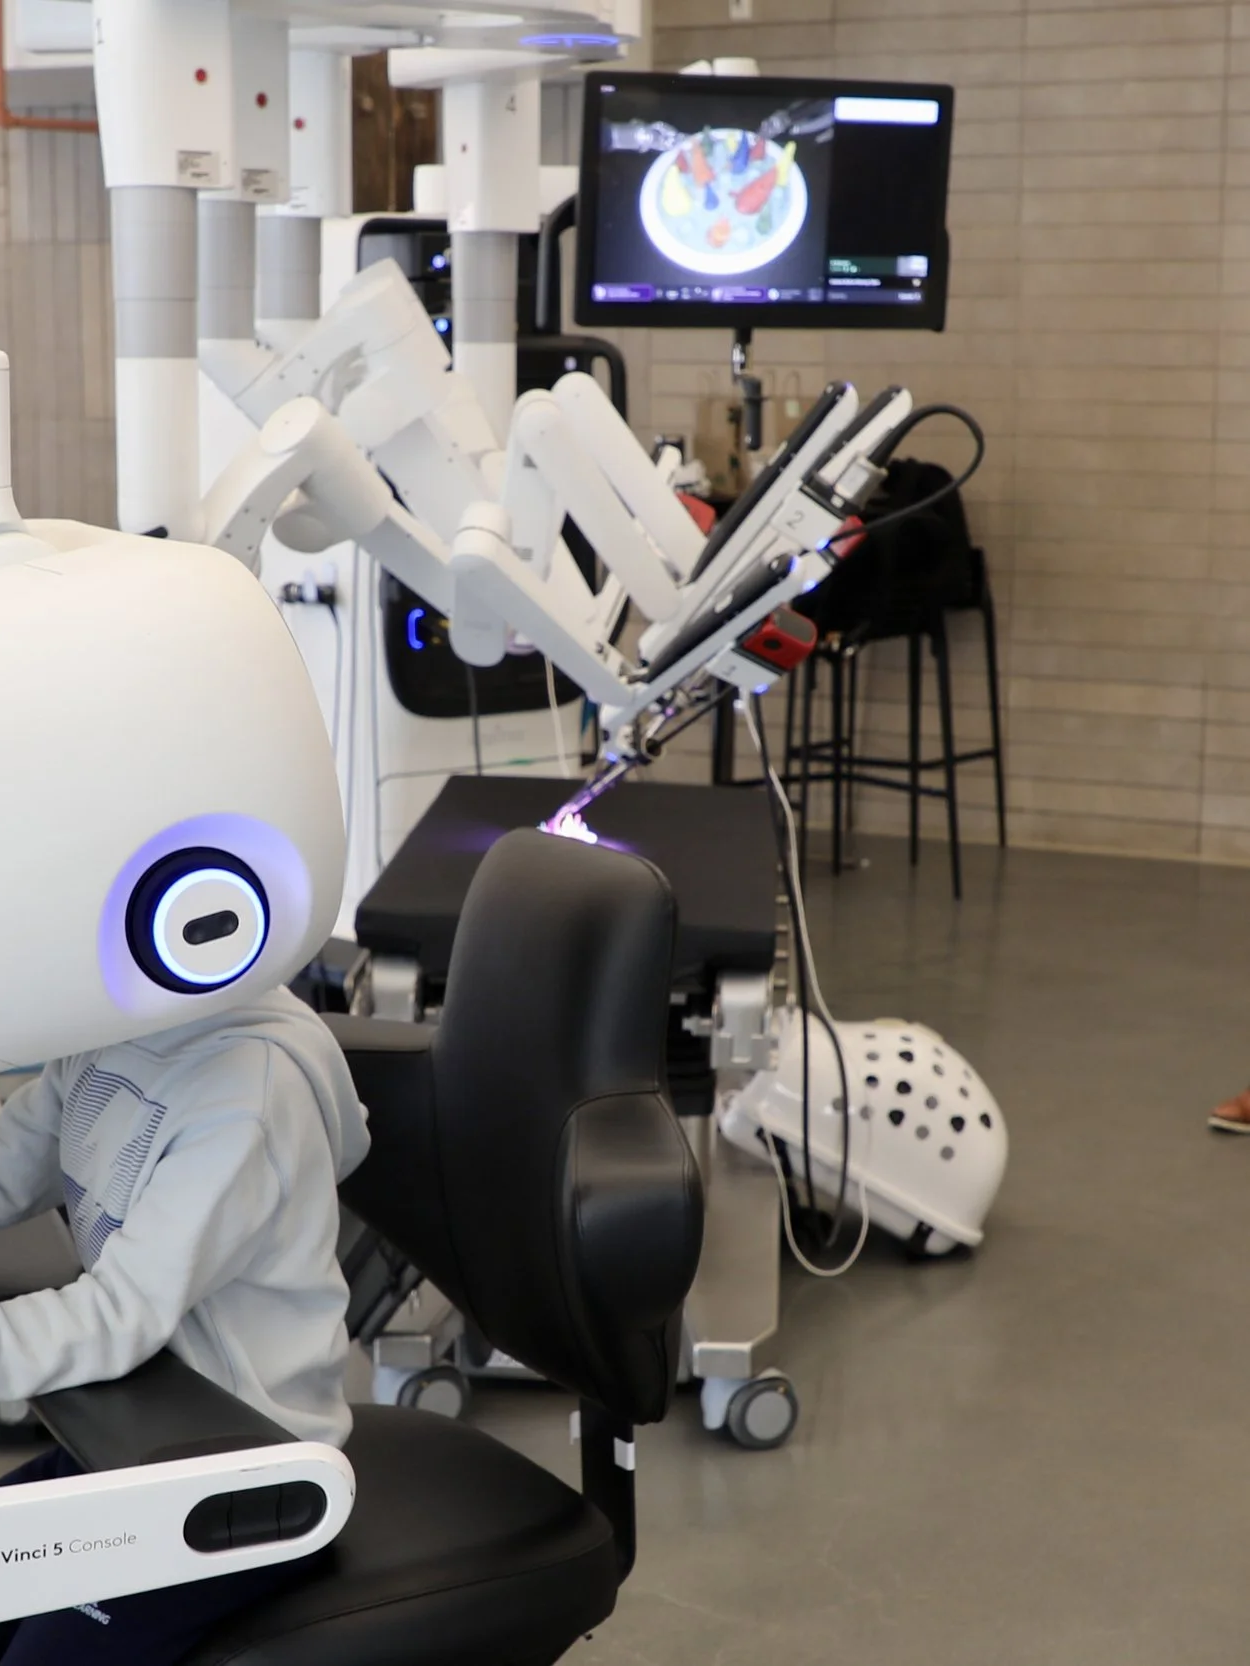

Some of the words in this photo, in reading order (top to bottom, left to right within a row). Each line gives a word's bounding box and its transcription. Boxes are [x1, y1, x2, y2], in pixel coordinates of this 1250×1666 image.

[505, 95, 517, 115] 4
[786, 510, 805, 530] 2
[1, 1544, 47, 1564] Vinci
[53, 1542, 63, 1556] 5
[68, 1531, 137, 1554] Console
